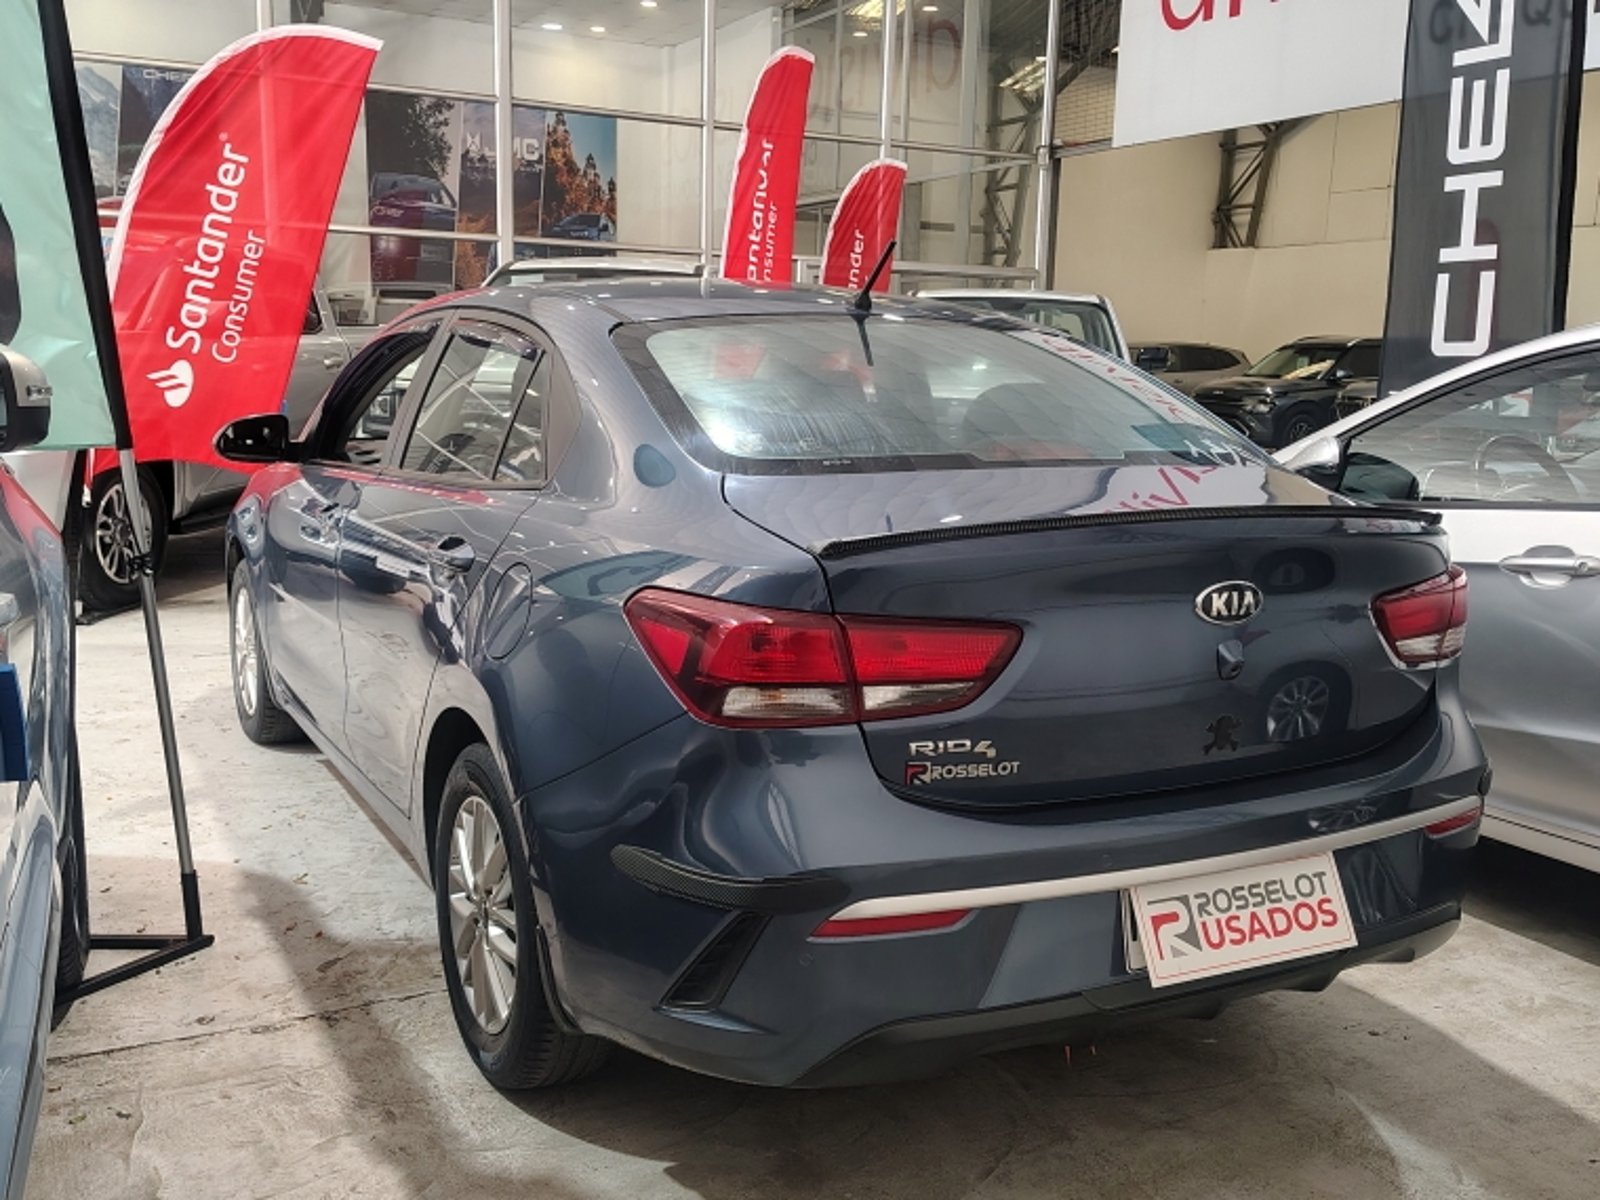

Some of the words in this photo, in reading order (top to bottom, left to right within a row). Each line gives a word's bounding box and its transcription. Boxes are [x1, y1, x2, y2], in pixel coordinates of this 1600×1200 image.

[165, 142, 249, 355] Santander
[211, 229, 267, 363] Consumer
[1210, 591, 1256, 617] KIA
[931, 761, 1020, 780] ROSSELOT
[1193, 871, 1327, 918] ROSSELOT
[1200, 897, 1339, 951] USADOS
